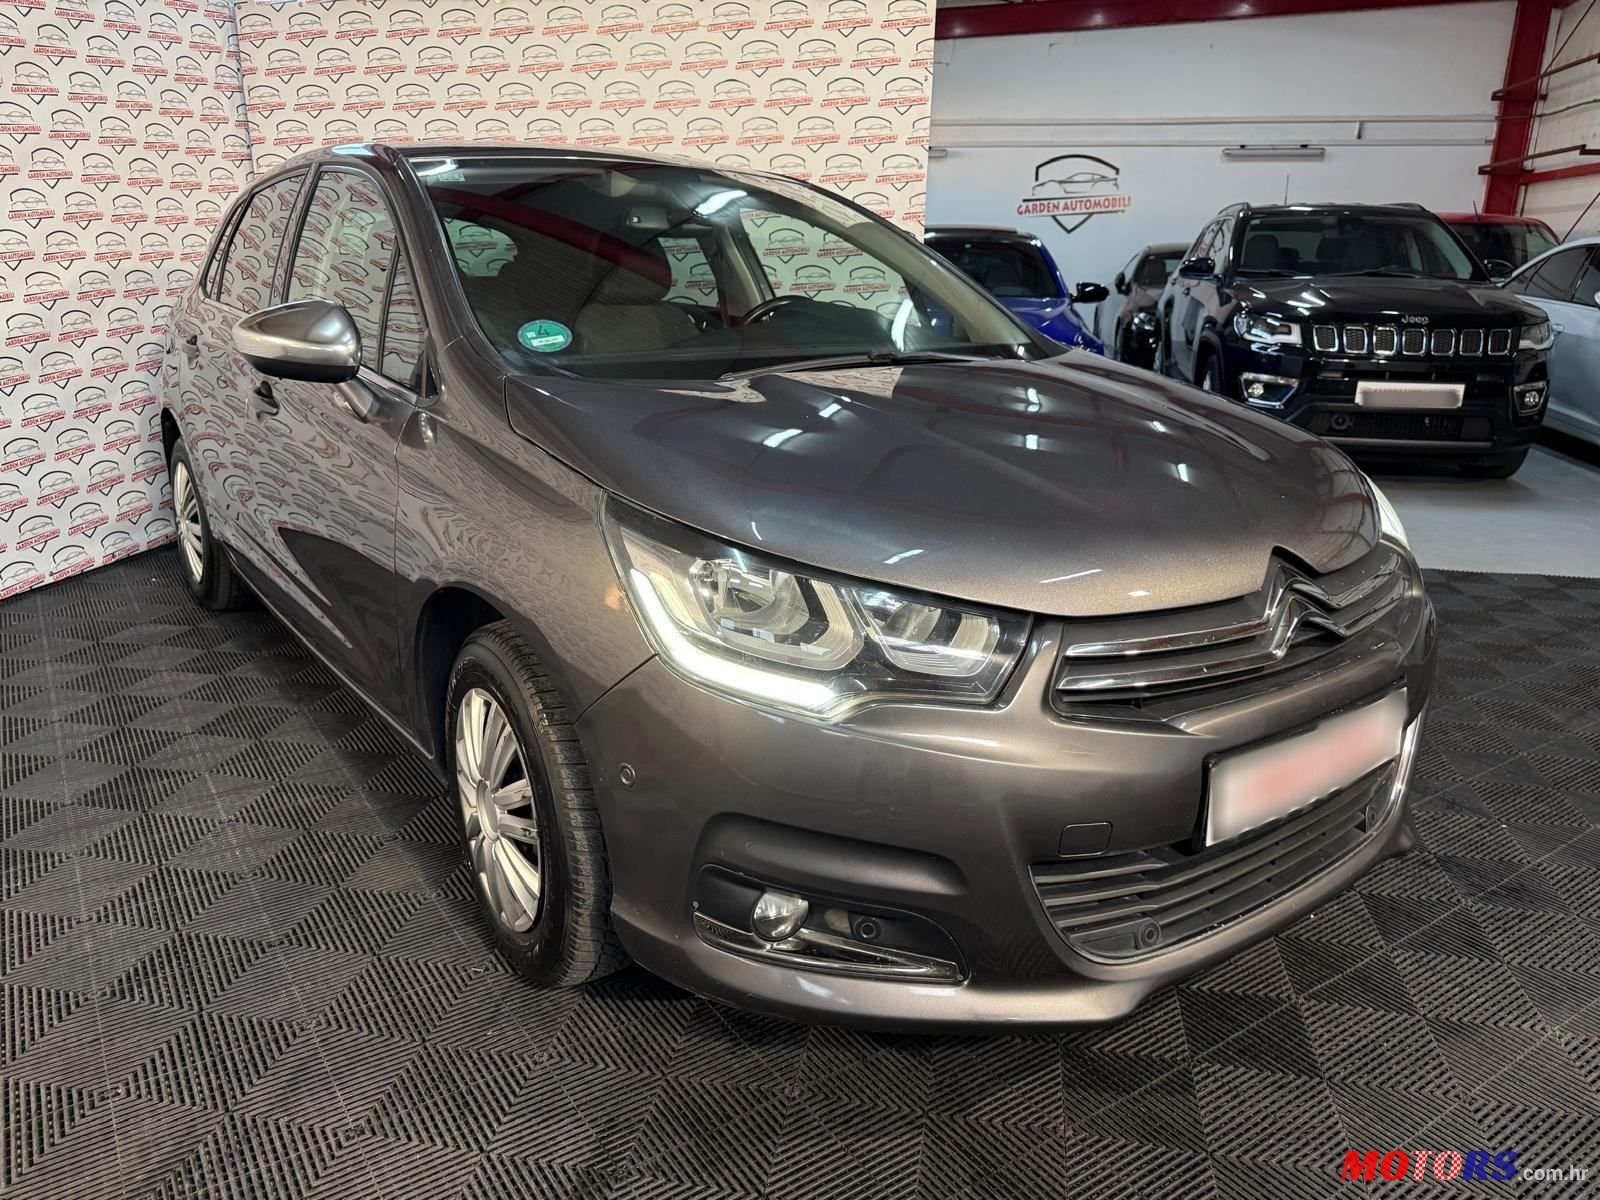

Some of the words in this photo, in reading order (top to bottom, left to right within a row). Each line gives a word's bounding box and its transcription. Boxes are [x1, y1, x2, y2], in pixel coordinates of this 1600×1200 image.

[652, 25, 669, 34] GARDEN
[708, 23, 726, 33] GARDEN
[764, 22, 783, 32] GARDEN
[824, 21, 842, 30] GARDEN
[881, 20, 900, 30] GARDEN
[596, 26, 614, 35] GARDEN
[518, 65, 535, 73] GARDEN
[571, 64, 589, 73] GARDEN
[625, 63, 642, 72] GARDEN
[680, 62, 698, 72] GARDEN
[737, 62, 754, 71] GARDEN
[793, 60, 811, 70] GARDEN
[850, 60, 869, 69] GARDEN
[415, 67, 432, 75] GARDEN
[467, 66, 483, 75] GARDEN
[394, 103, 410, 112] GARDEN
[444, 103, 460, 112] GARDEN
[495, 103, 512, 112] GARDEN
[548, 101, 565, 111] GARDEN
[600, 101, 617, 110] GARDEN
[654, 101, 672, 110] GARDEN
[710, 101, 727, 110] GARDEN
[765, 100, 782, 109] GARDEN
[822, 99, 840, 108] GARDEN
[879, 99, 898, 108] GARDEN
[628, 138, 645, 146] GARDEN
[682, 138, 700, 146] GARDEN
[736, 137, 754, 146] GARDEN
[792, 137, 810, 145] GARDEN
[848, 137, 867, 147] GARDEN
[818, 175, 836, 184] GARDEN
[876, 176, 894, 184] GARDEN
[1017, 202, 1059, 215] GARDEN
[1062, 196, 1131, 212] AUTOMOBILI
[1401, 314, 1429, 325] Jeep
[6, 337, 22, 347] GARDEN
[58, 332, 73, 343] GARDEN
[91, 367, 105, 377] GARDEN
[39, 373, 55, 385] GARDEN
[72, 408, 87, 420] GARDEN
[21, 417, 37, 429] GARDEN
[54, 450, 70, 463] GARDEN
[0, 461, 17, 474] GARDEN
[38, 493, 53, 507] GARDEN
[69, 524, 84, 538] GARDEN
[16, 538, 32, 551] GARDEN
